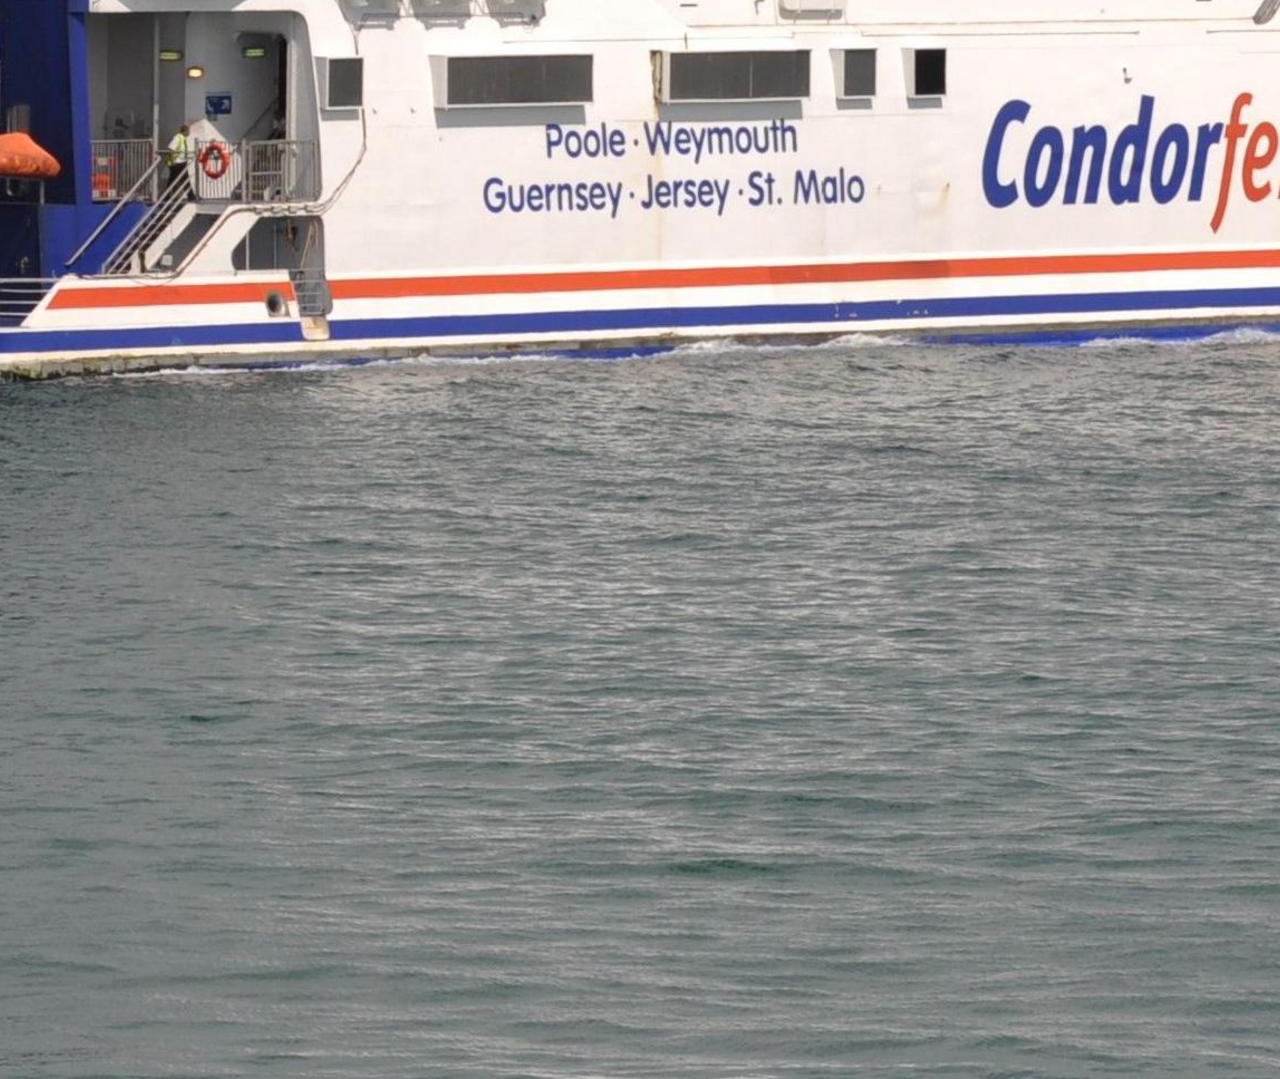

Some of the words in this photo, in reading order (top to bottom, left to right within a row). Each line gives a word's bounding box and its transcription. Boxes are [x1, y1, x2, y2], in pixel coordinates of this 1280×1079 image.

[546, 122, 626, 158] Poole
[645, 118, 798, 164] Weymouth
[483, 176, 622, 218] Guernsey
[640, 174, 730, 216] Jersey
[748, 170, 782, 206] St.
[793, 167, 865, 204] Malo
